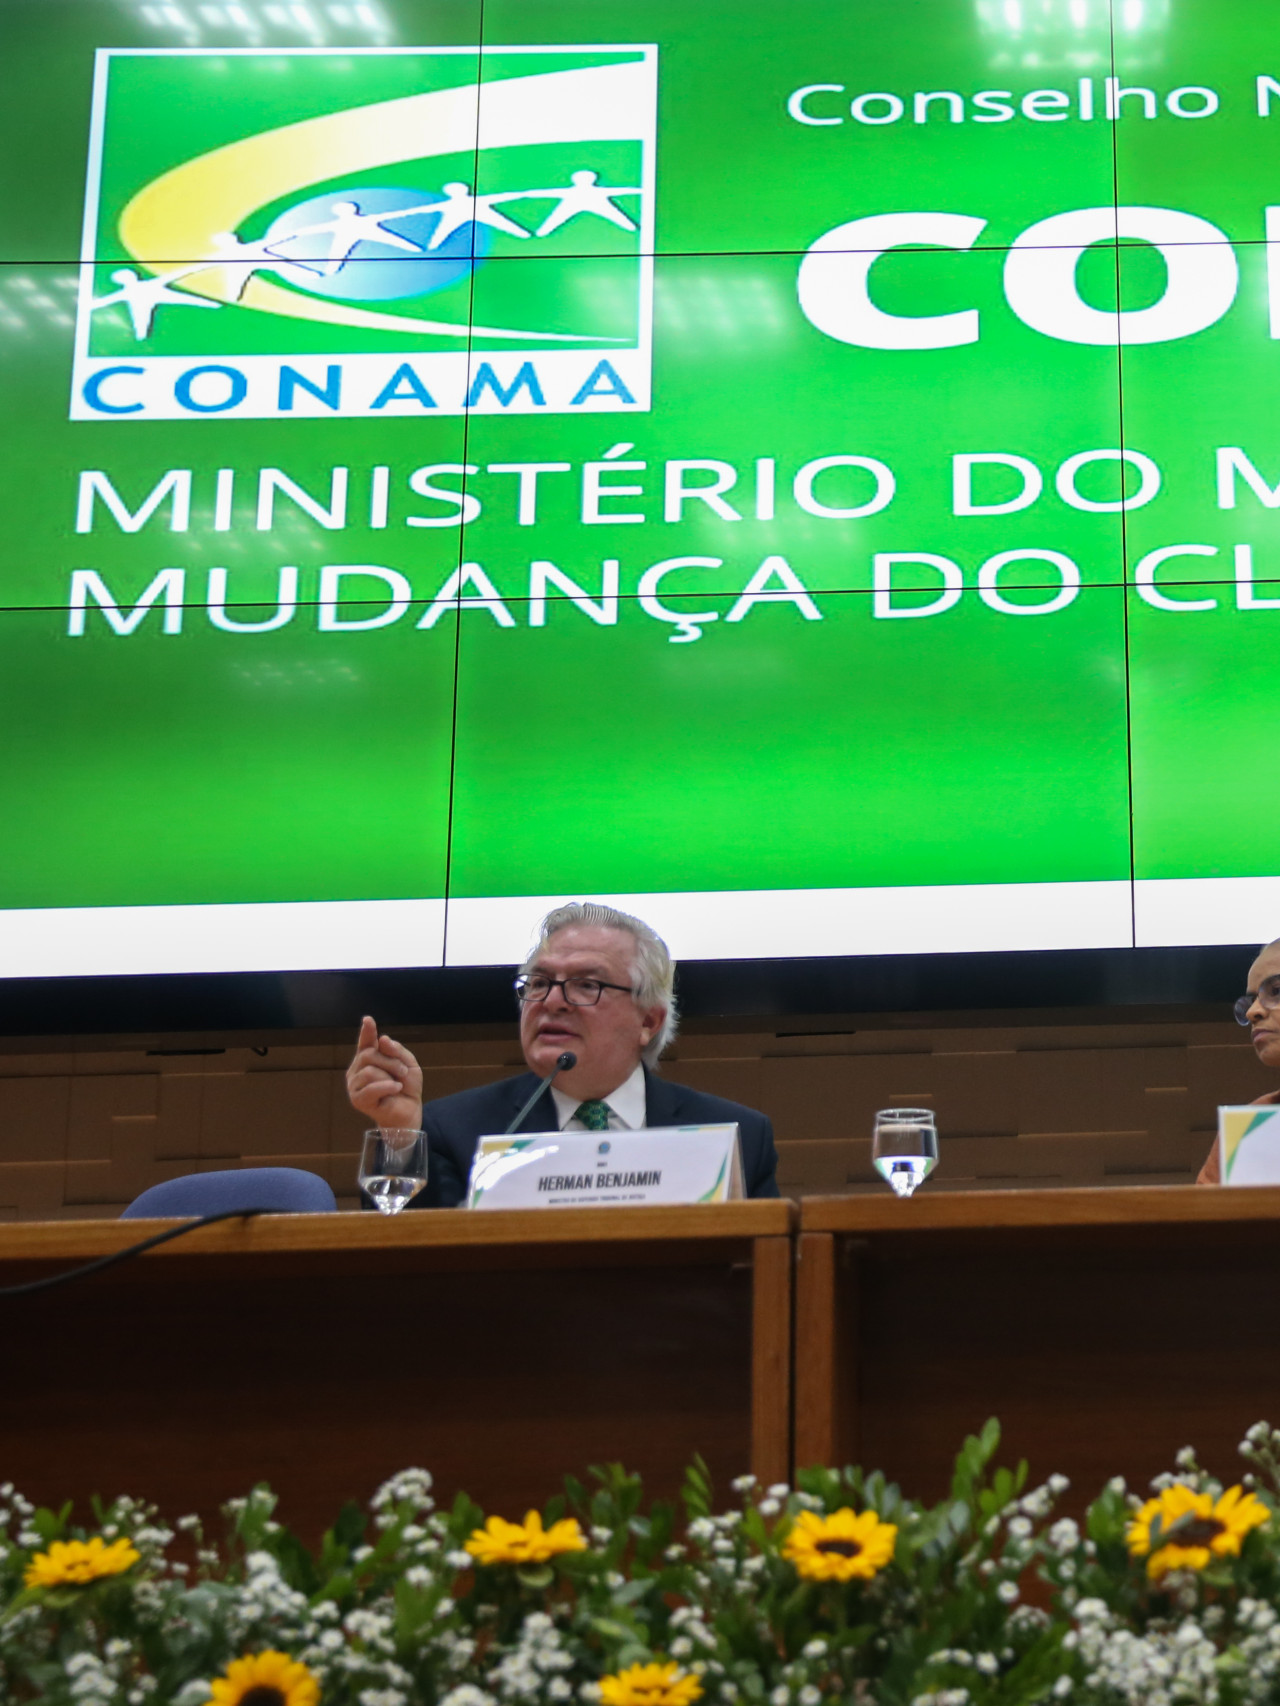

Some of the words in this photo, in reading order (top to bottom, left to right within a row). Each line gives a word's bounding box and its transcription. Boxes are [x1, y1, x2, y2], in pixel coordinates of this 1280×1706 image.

[787, 77, 1220, 127] Conselho
[82, 359, 638, 414] CONAMA
[75, 443, 896, 534] MINISTÉRIO
[951, 449, 1162, 517] DO
[66, 556, 823, 644] MUDANÇA
[872, 548, 1081, 620] DO
[538, 1174, 593, 1191] HERMAN
[596, 1170, 662, 1187] BENJAMIN
